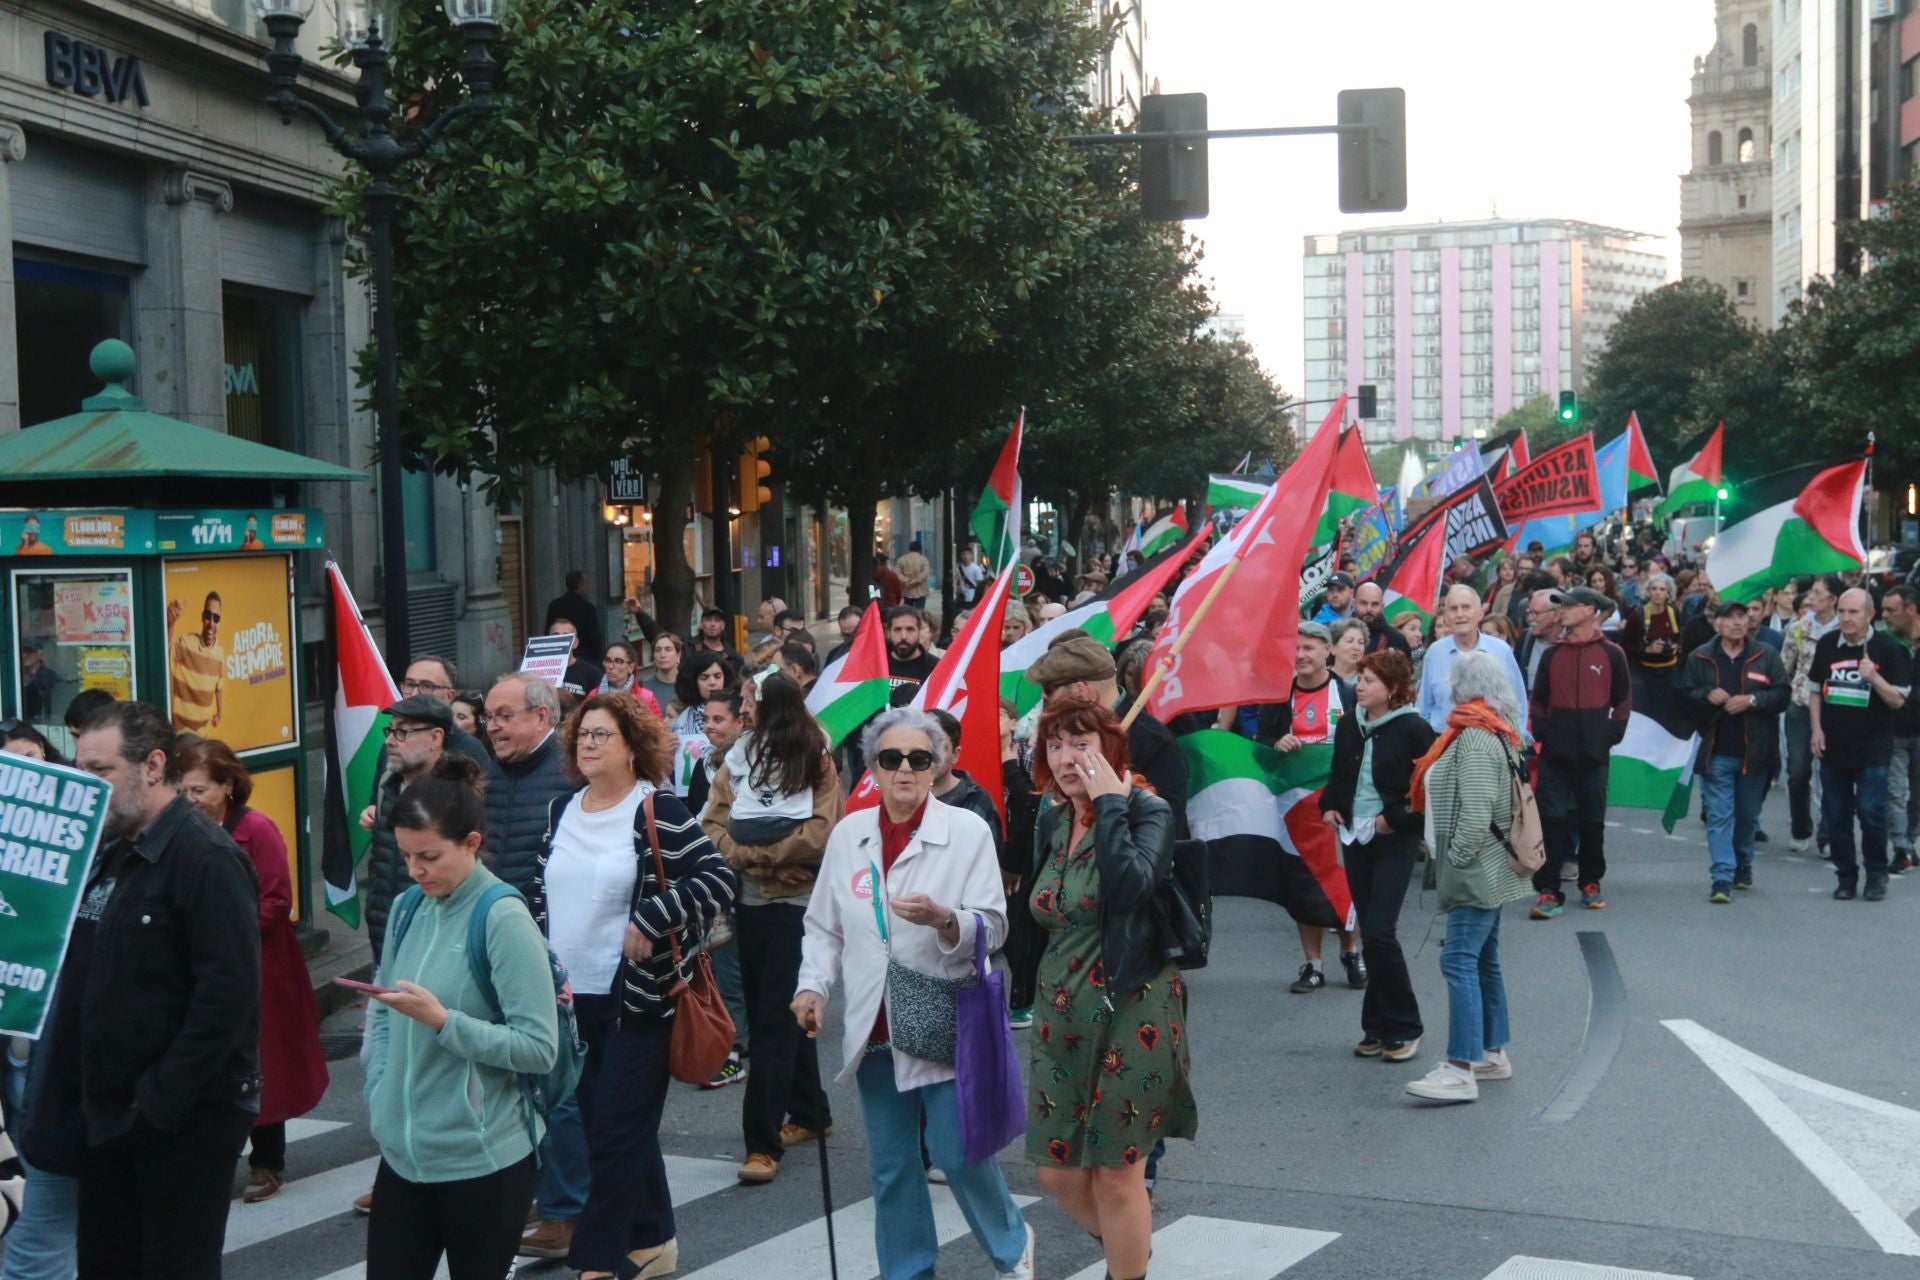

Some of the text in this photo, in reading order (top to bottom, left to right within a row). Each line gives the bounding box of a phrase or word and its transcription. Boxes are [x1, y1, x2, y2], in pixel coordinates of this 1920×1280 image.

[44, 30, 150, 107] BBVA
[191, 524, 233, 544] 11/11
[233, 621, 275, 654] AHORA
[226, 642, 284, 680] SIEMPRE
[58, 780, 101, 817] DE
